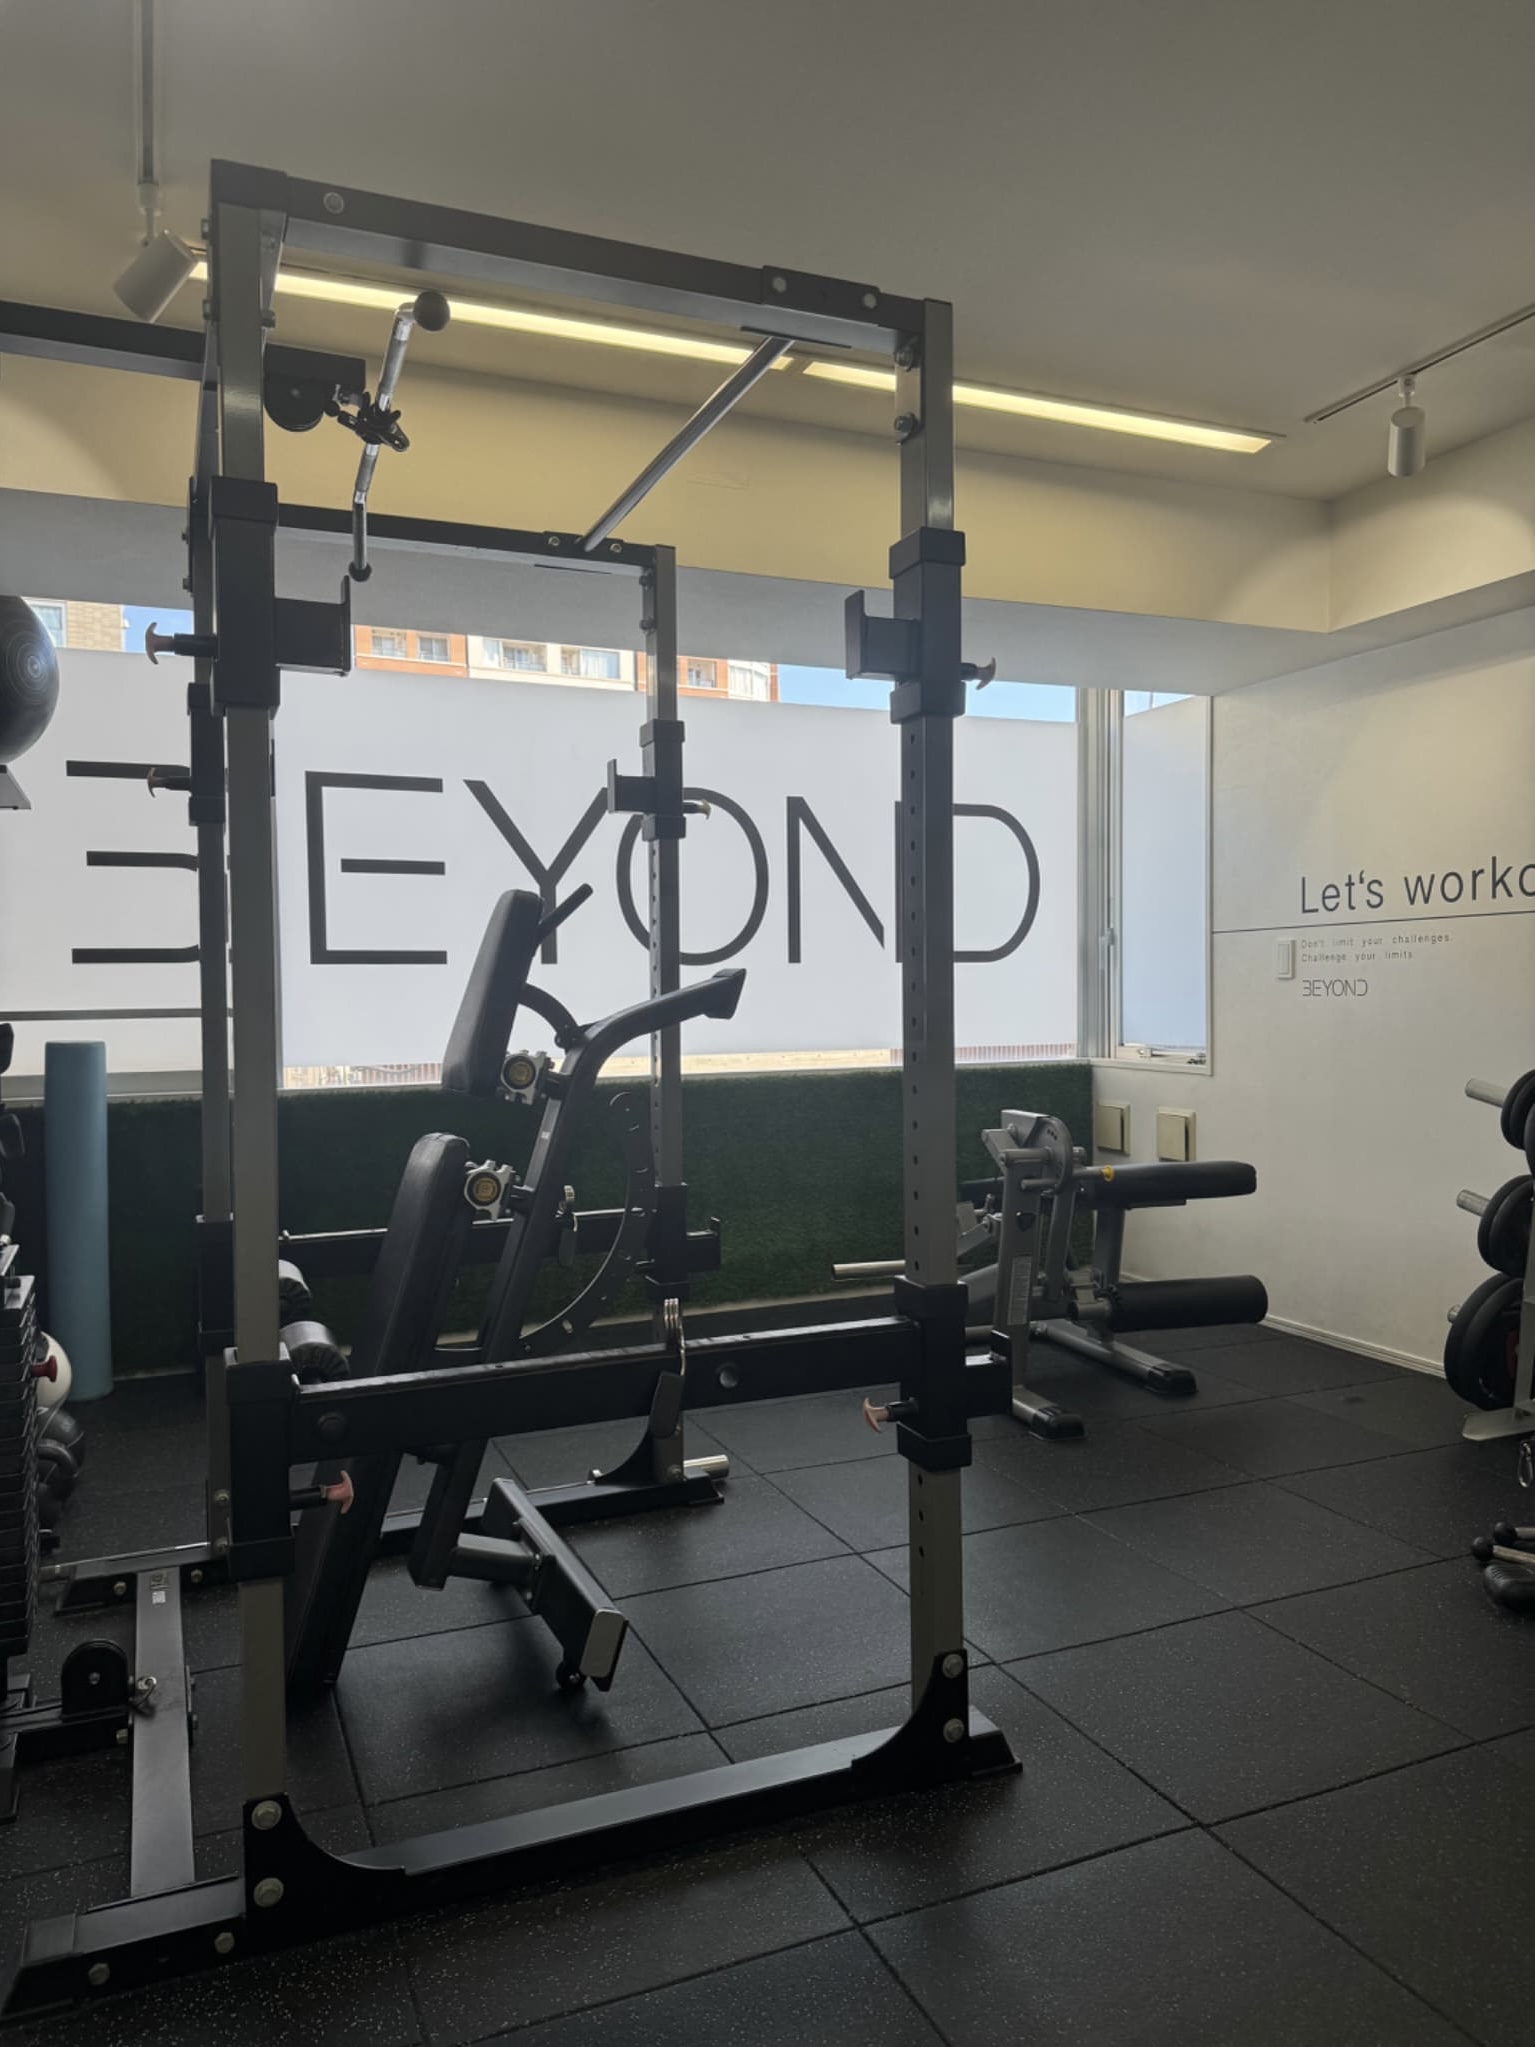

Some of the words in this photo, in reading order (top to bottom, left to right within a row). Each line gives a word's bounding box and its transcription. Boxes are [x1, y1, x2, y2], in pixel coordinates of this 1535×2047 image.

[1302, 870, 1384, 914] Let's
[1301, 939, 1325, 949] Don't
[1332, 938, 1353, 947] limit
[1362, 937, 1383, 948] your
[1301, 952, 1347, 963] Challenge
[1355, 952, 1376, 963] your
[1385, 950, 1413, 960] limits
[1302, 978, 1369, 998] BEYOND
